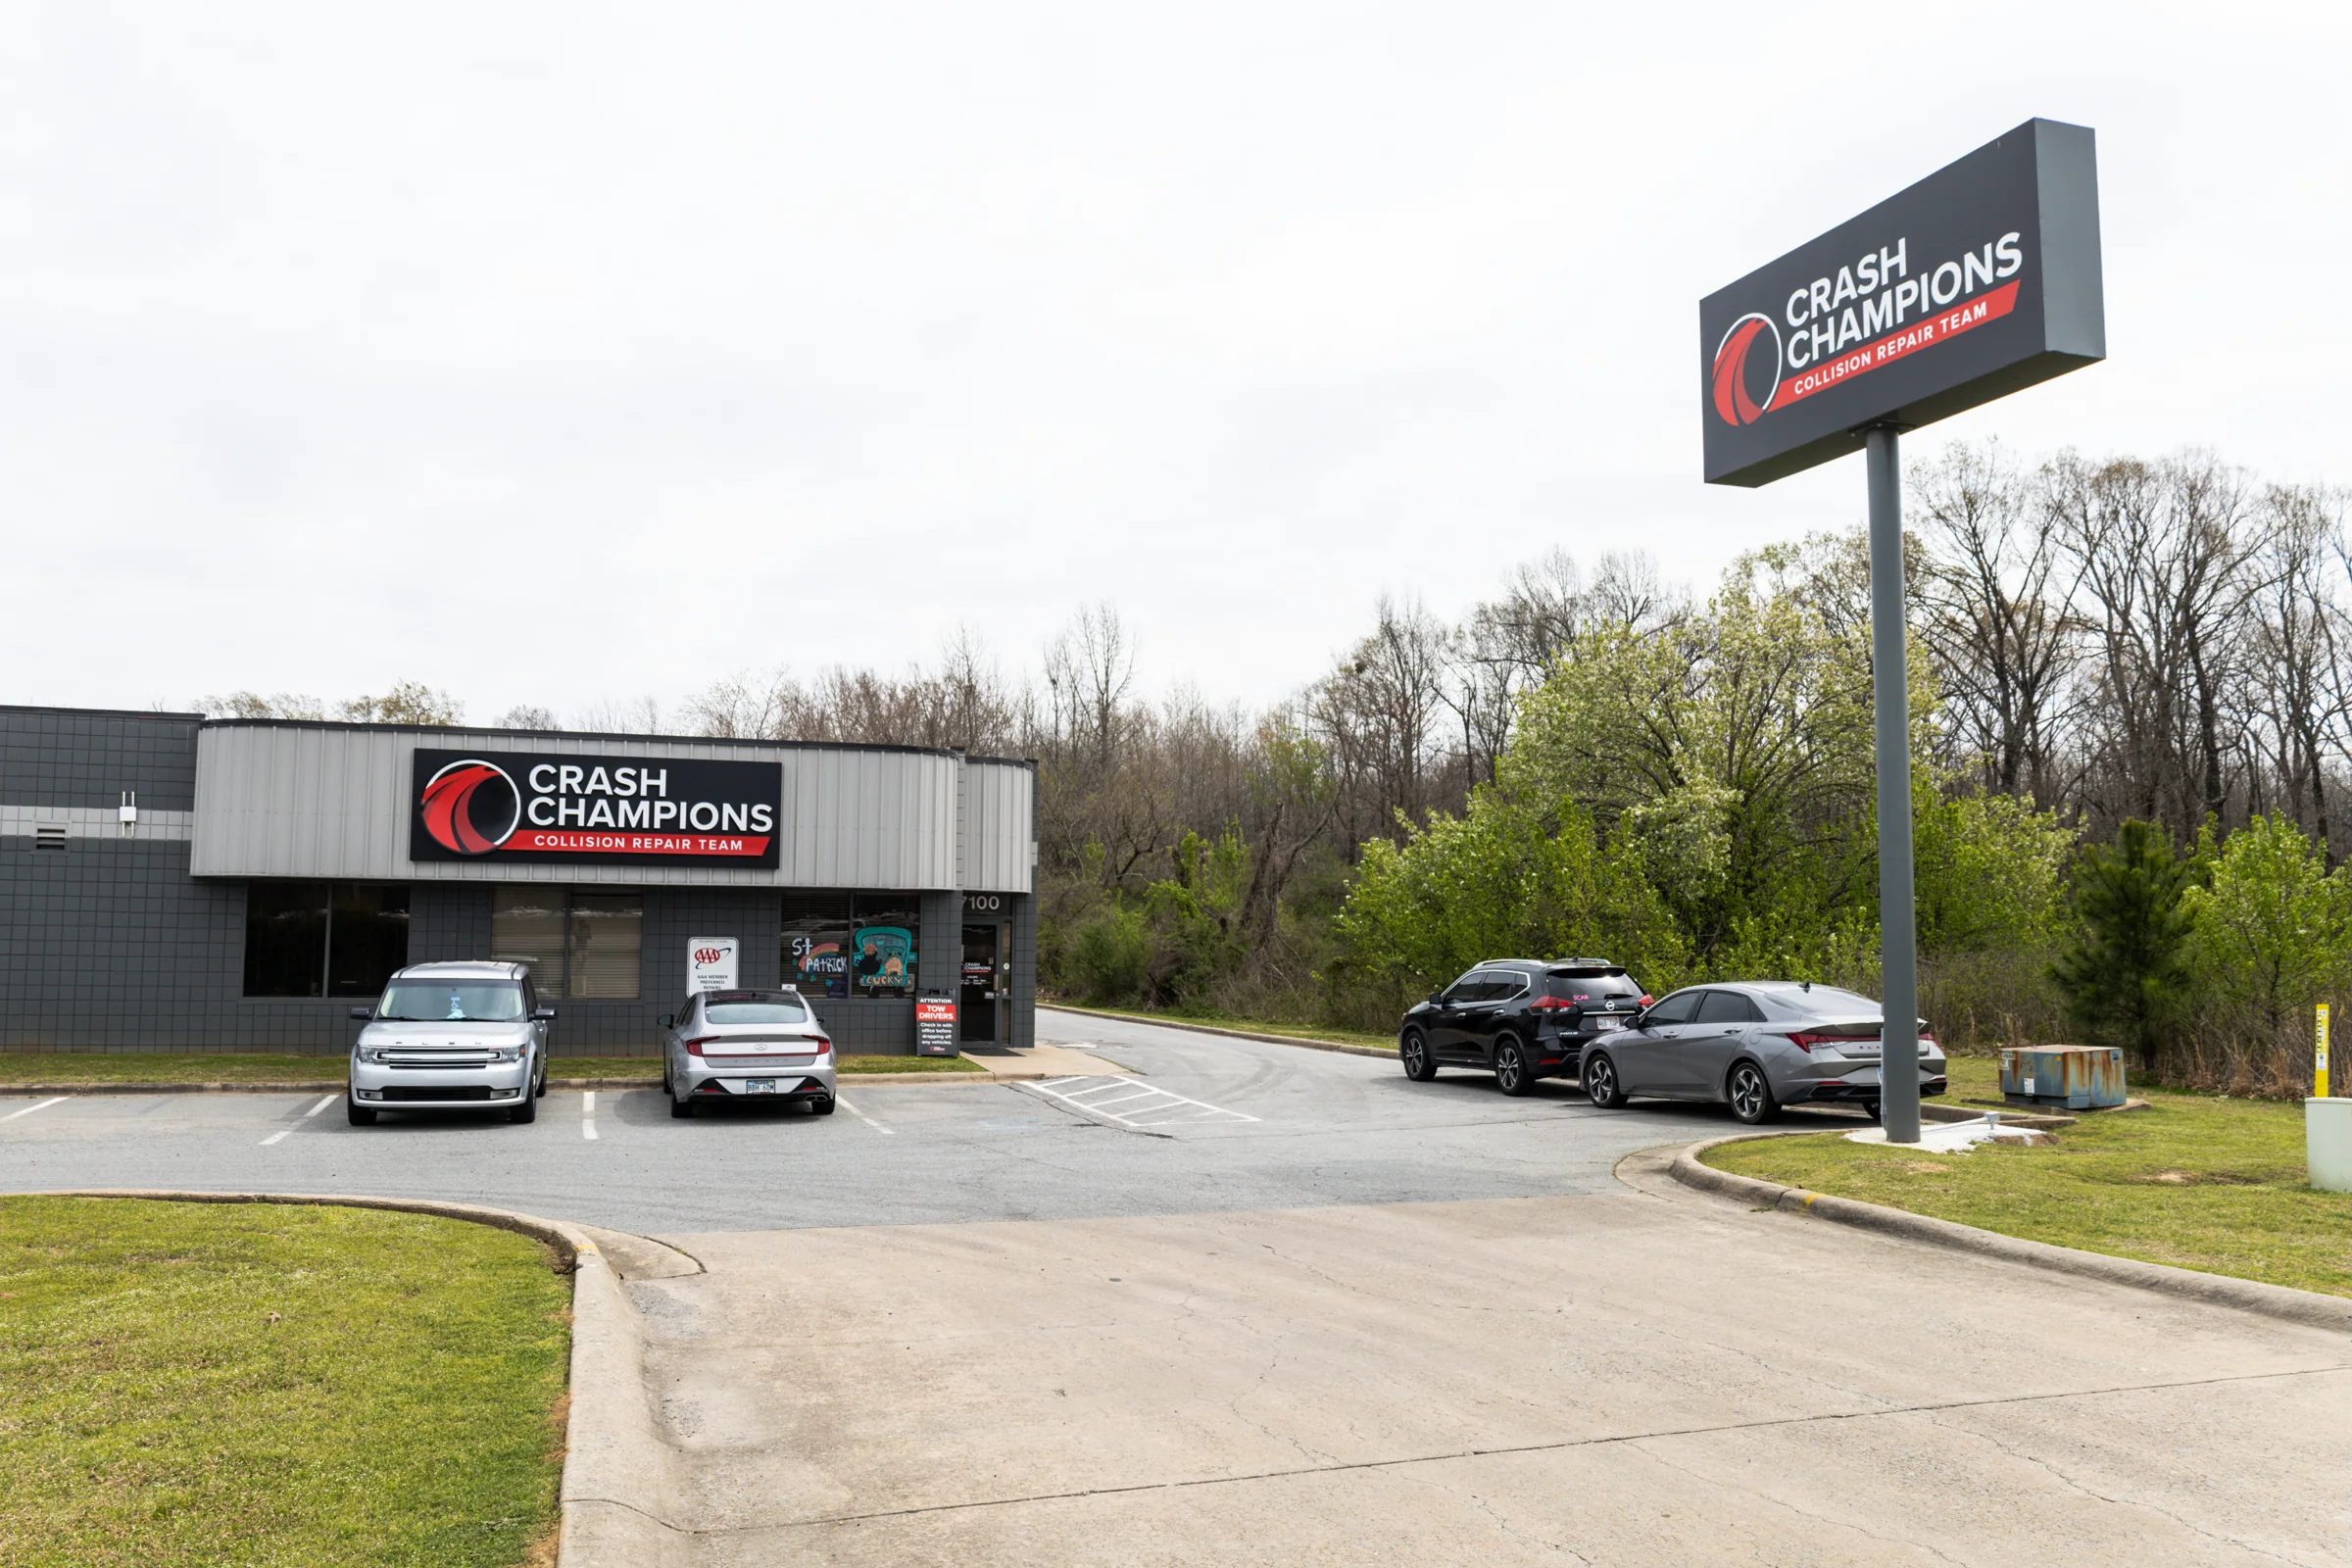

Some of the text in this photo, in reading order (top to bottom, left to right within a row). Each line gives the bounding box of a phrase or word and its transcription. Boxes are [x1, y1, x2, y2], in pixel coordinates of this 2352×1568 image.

[1786, 236, 1907, 327] CRASH
[1787, 231, 2023, 369] CHAMPIONS
[1794, 301, 1987, 395] COLLISION REPAIR TEAM
[528, 763, 666, 798] CRASH
[527, 796, 773, 833] CHAMPIONS
[534, 834, 743, 852] COLLISION REPAIR TEAM
[866, 976, 903, 985] LUCKY
